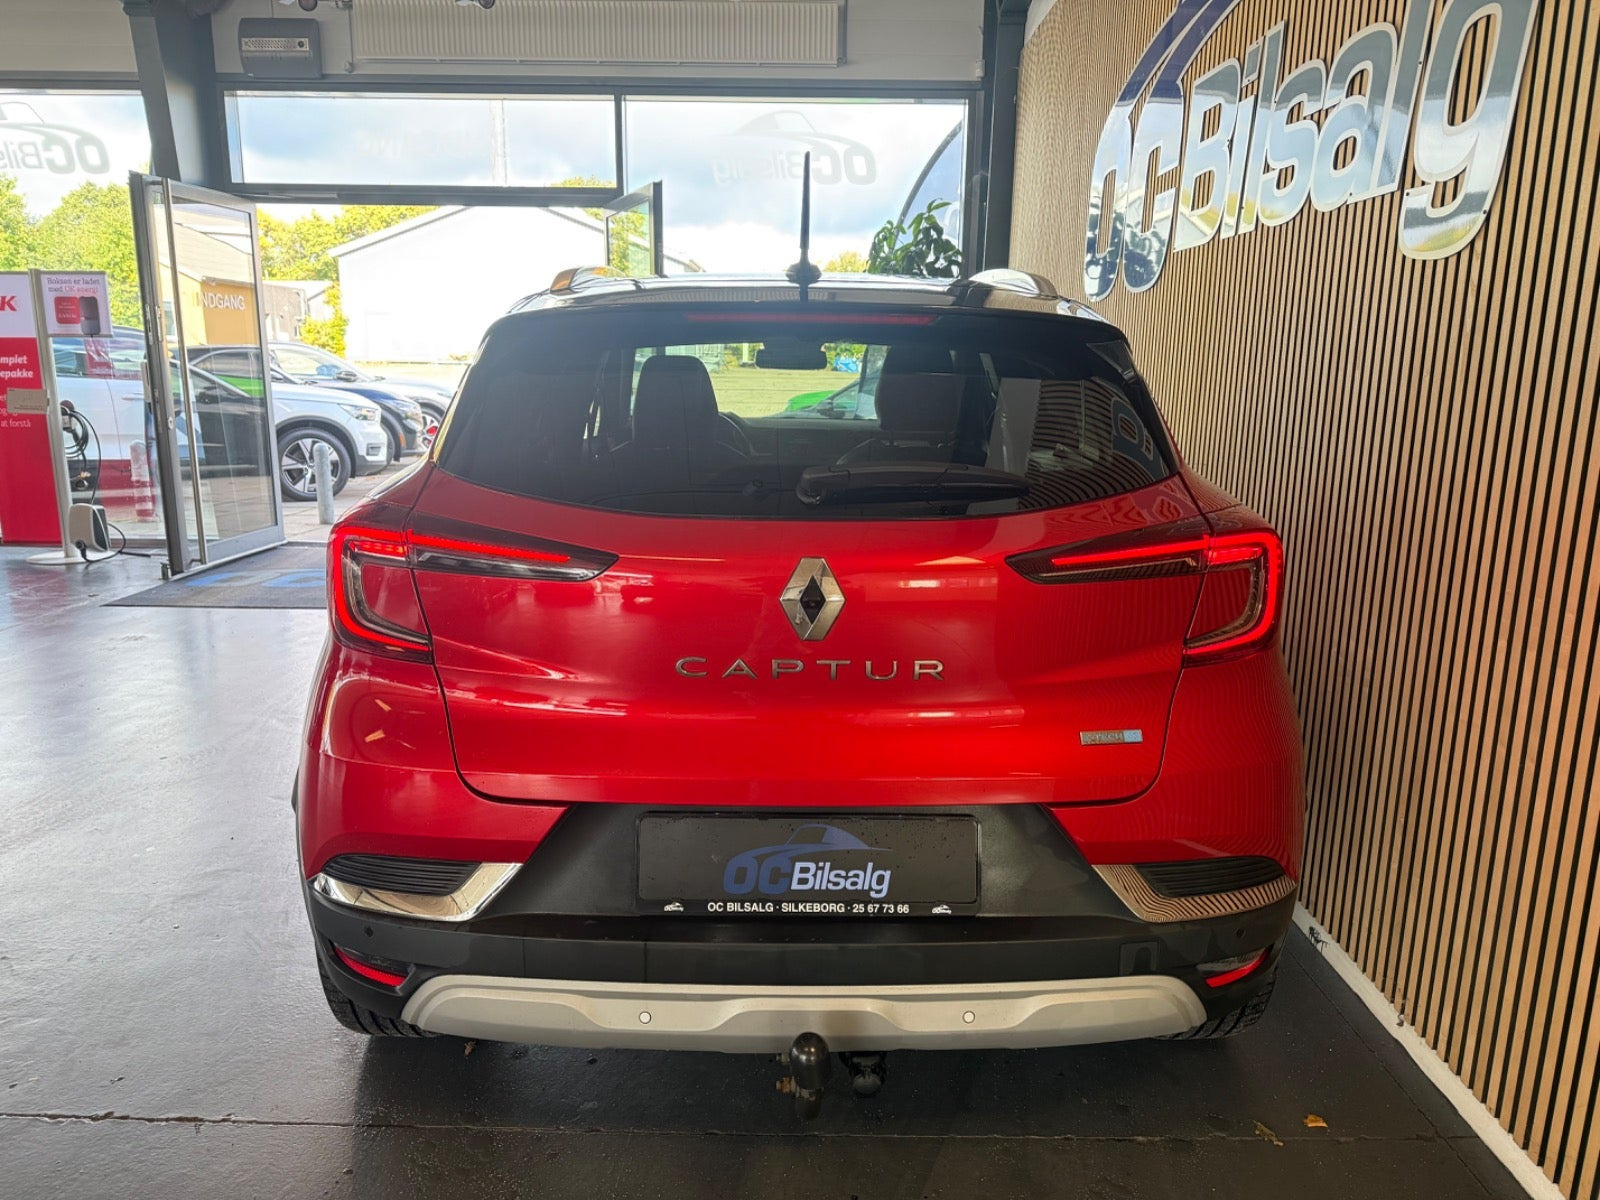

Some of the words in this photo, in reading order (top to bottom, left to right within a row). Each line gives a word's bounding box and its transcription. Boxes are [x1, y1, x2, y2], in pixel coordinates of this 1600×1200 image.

[0, 295, 17, 312] K
[675, 656, 944, 681] CAPTUR
[707, 902, 724, 912] OC
[726, 902, 774, 912] BILSALG
[781, 902, 845, 913] SILKEBORG
[852, 904, 865, 913] 25
[867, 904, 880, 913] 67
[882, 904, 895, 914] 73
[897, 904, 910, 914] 66
